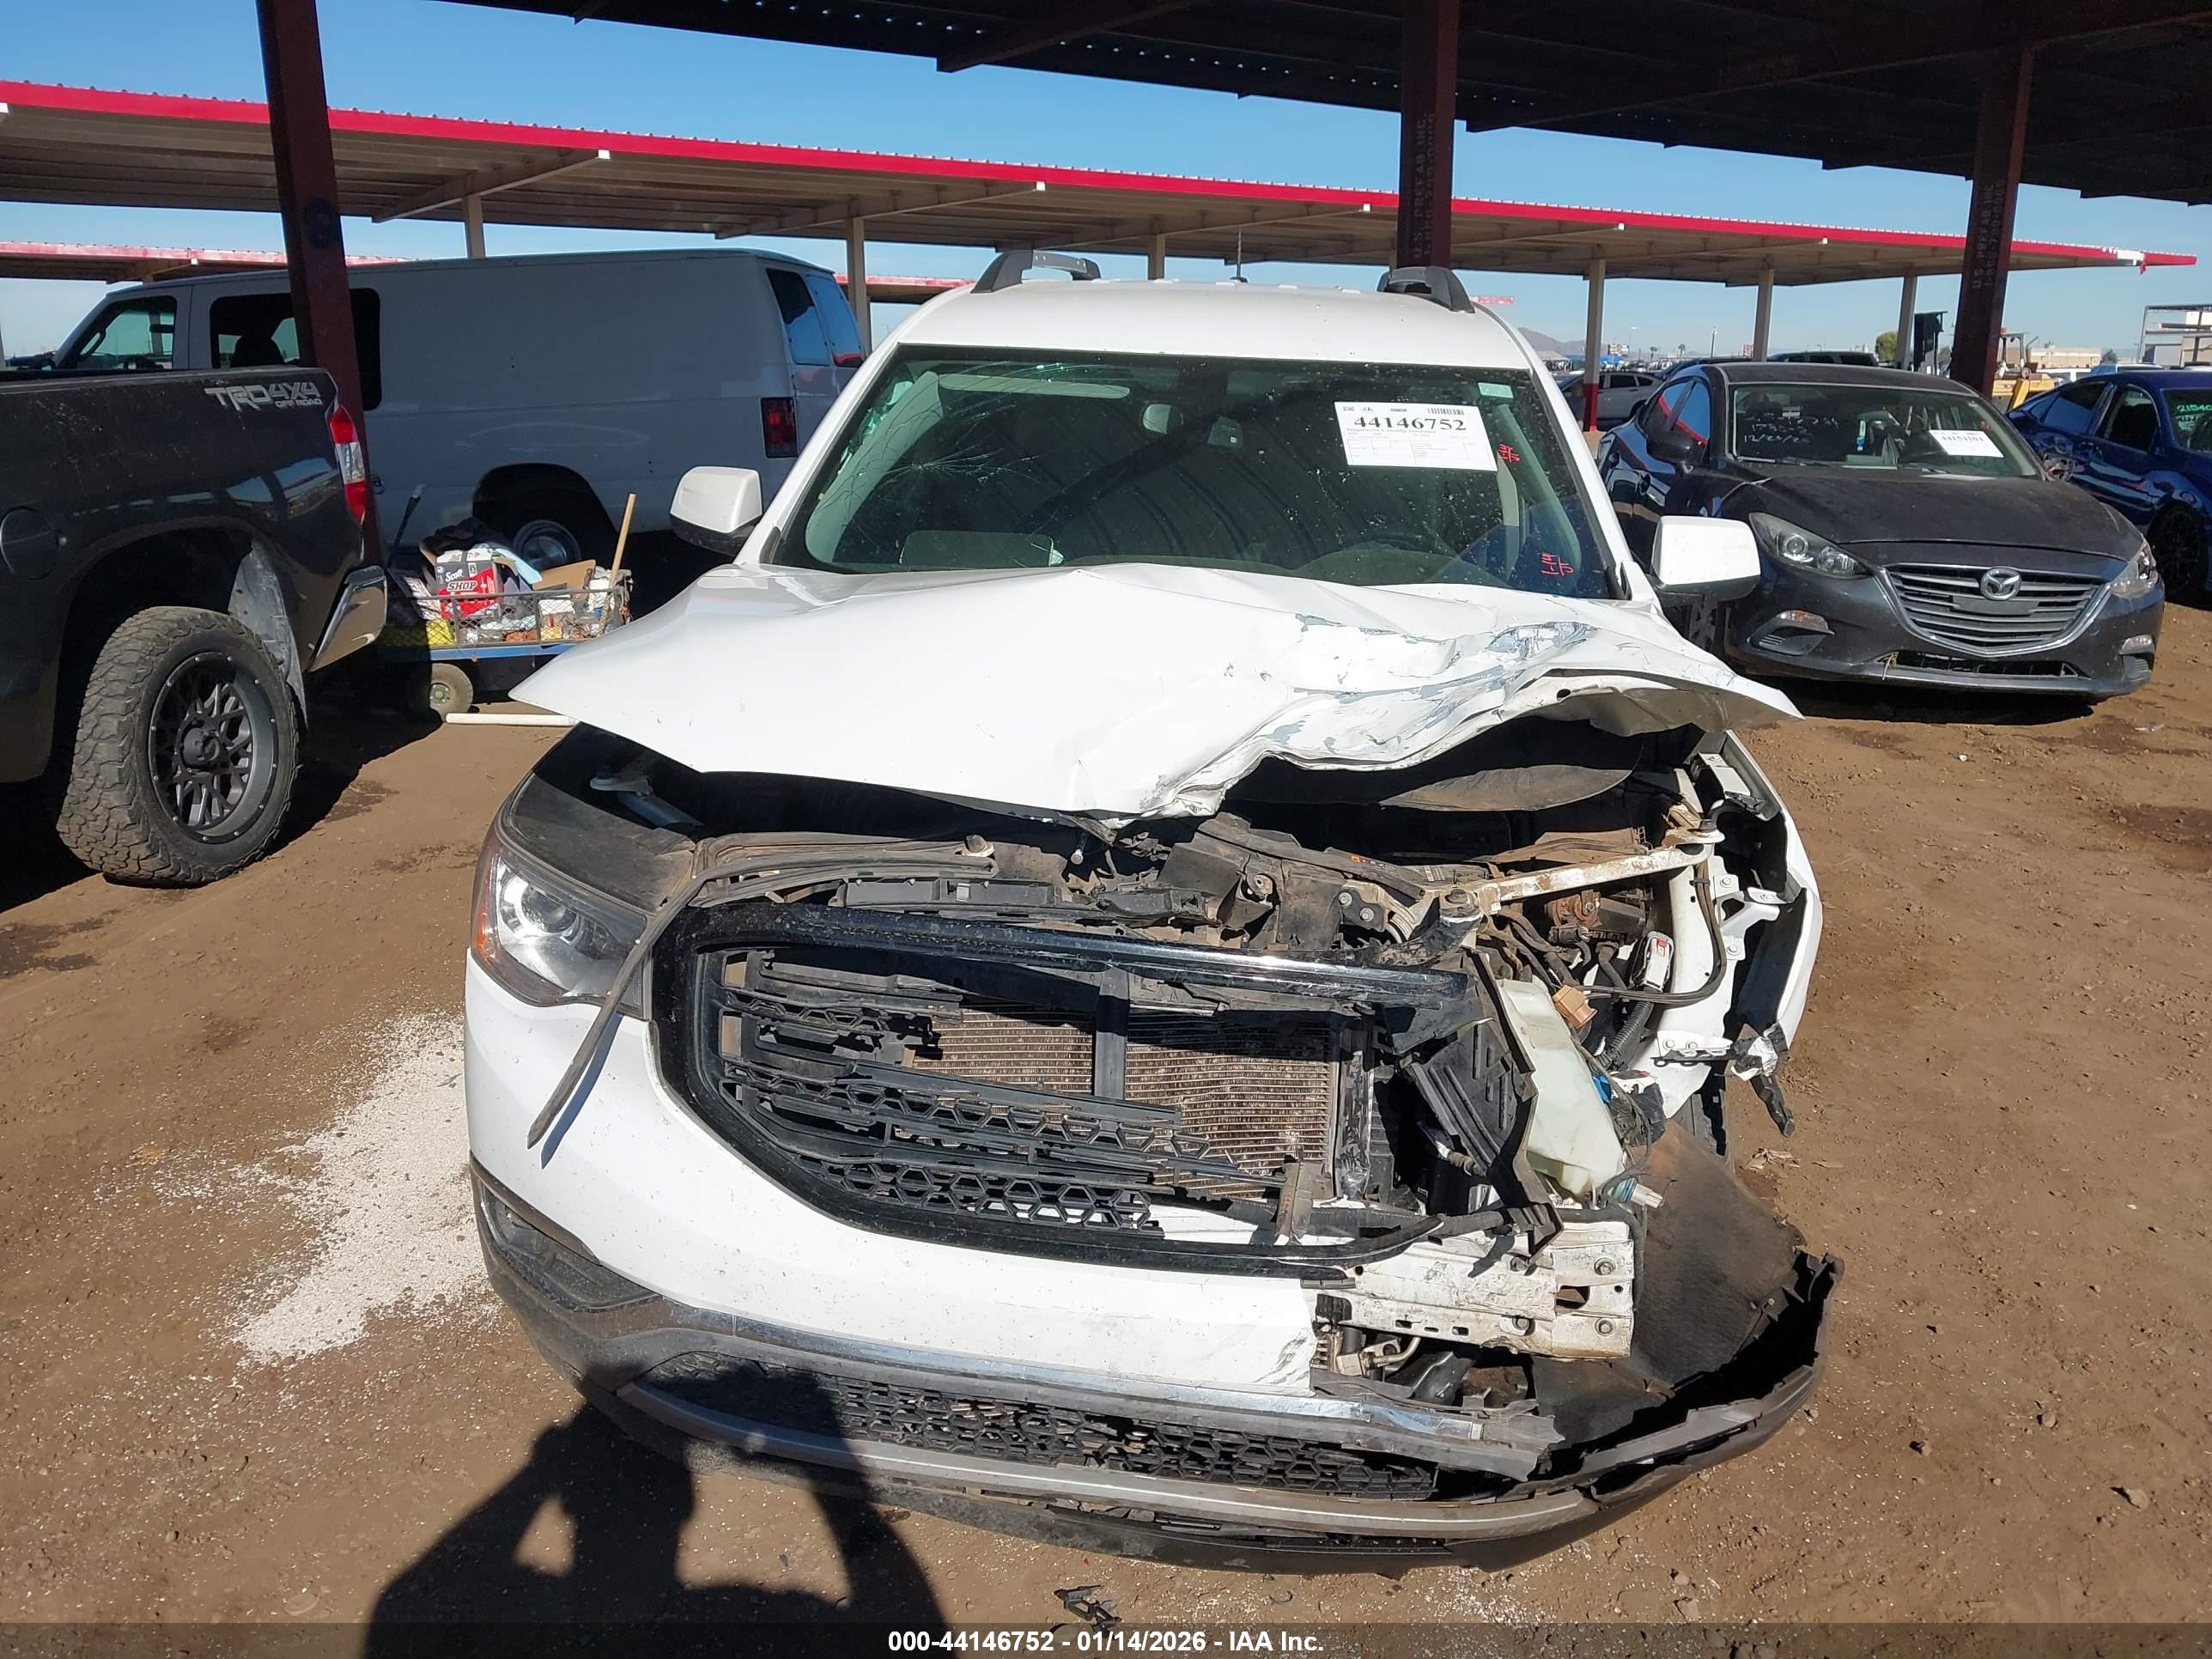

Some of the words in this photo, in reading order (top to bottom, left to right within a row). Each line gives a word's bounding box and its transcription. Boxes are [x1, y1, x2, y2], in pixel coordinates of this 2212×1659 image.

[204, 385, 273, 410] TRD
[274, 398, 295, 408] OFF
[295, 398, 323, 406] ROAD
[1354, 416, 1467, 431] 44146752
[445, 568, 464, 582] Scott
[447, 581, 477, 592] SHOP
